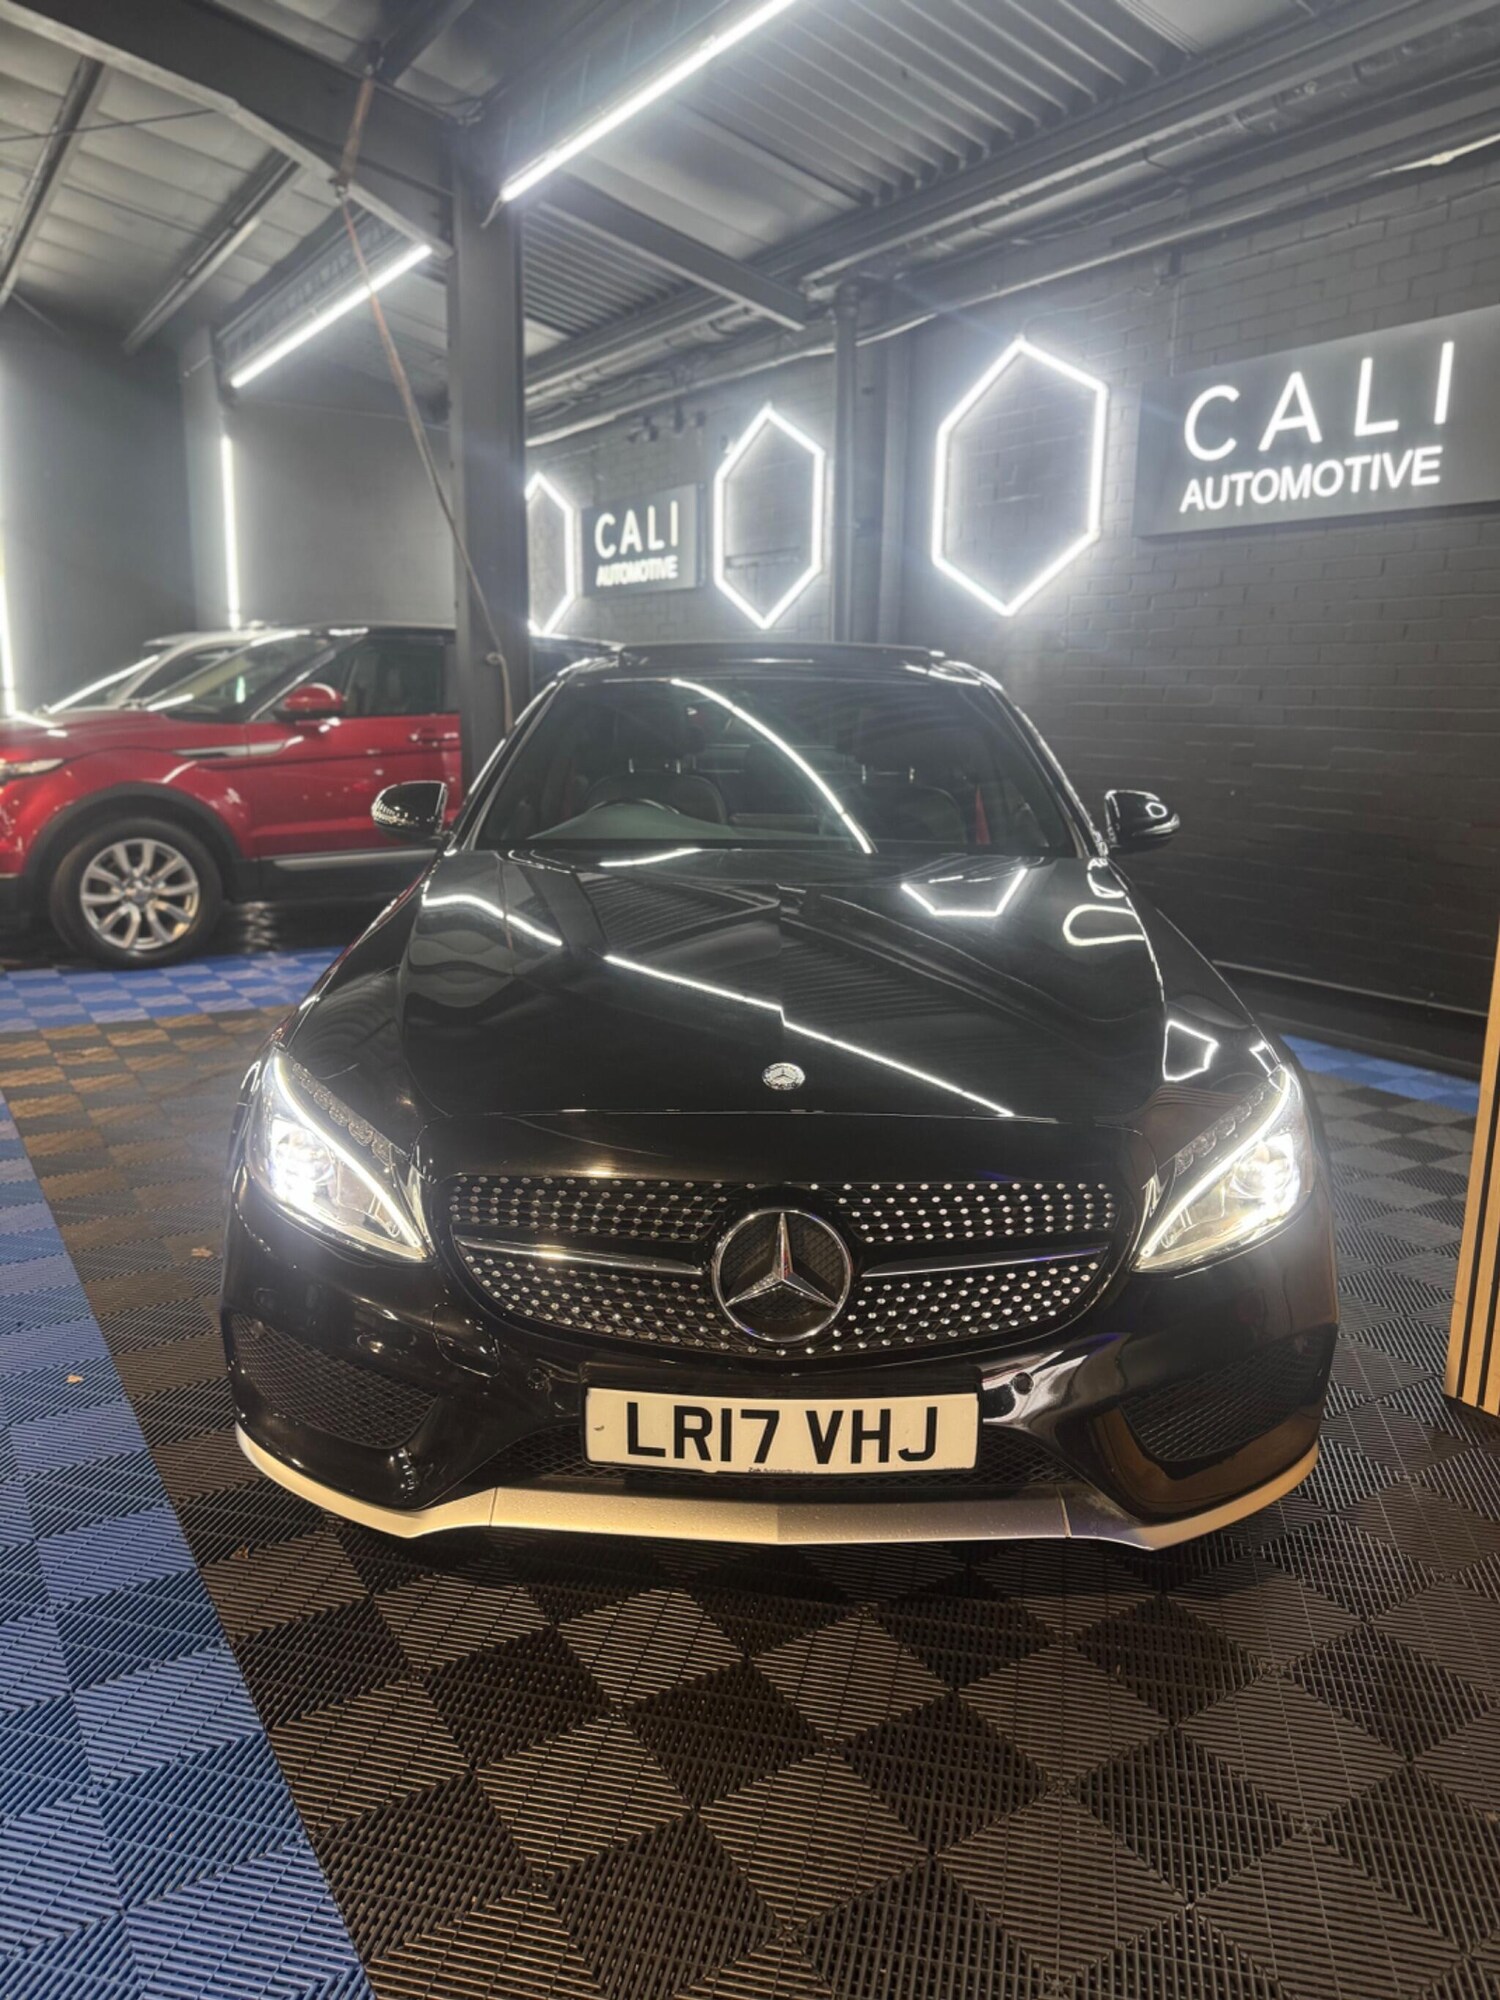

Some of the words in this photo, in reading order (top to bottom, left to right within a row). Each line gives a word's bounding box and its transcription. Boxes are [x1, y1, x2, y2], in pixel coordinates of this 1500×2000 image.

[1185, 340, 1454, 461] CALI
[1179, 445, 1443, 513] AUTOMOTIVE
[594, 500, 678, 559] CALI
[596, 555, 678, 586] AUTOMOTIVE
[627, 1401, 779, 1464] LR17
[806, 1406, 938, 1465] VHJ
